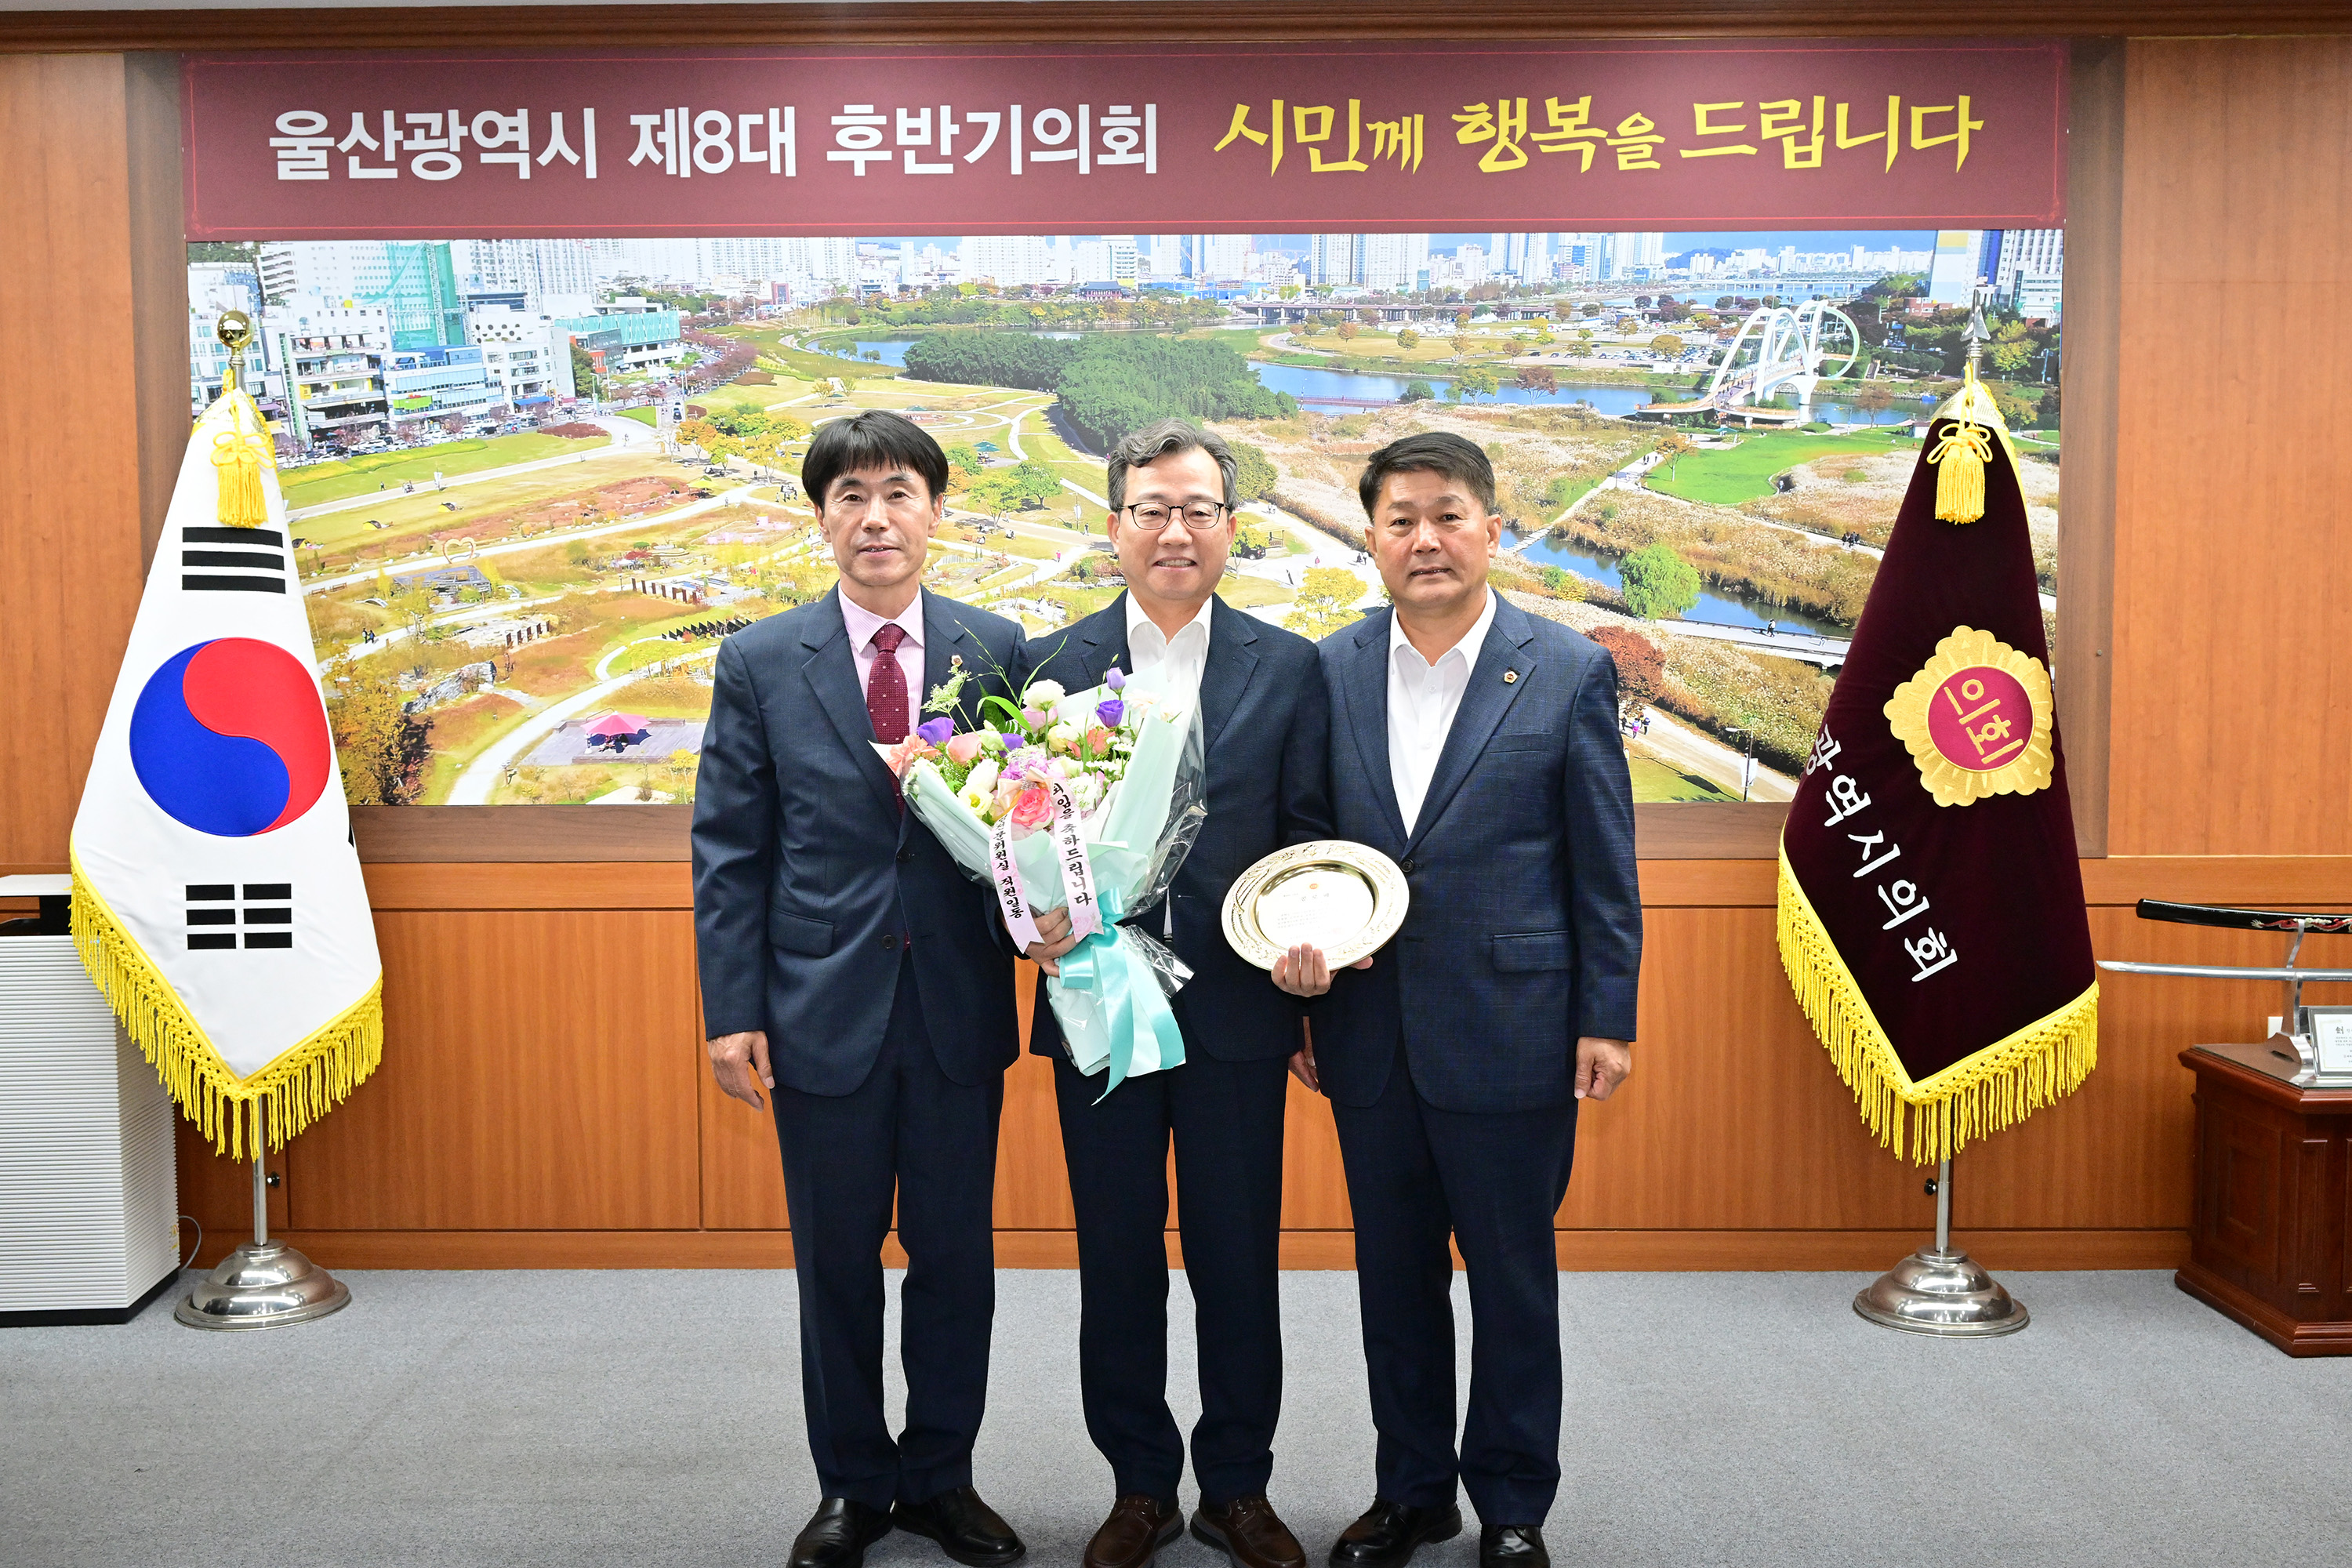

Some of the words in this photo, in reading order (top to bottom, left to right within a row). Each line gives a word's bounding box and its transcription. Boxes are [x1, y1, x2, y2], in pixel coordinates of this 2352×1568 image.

[269, 107, 597, 180] 울산광역시
[627, 106, 797, 178] 제8대
[826, 103, 1157, 176] 후반기의회
[1214, 98, 1425, 177] 시민께
[1451, 95, 1666, 173] 행복을
[1679, 95, 1984, 173] 드립니다
[1943, 677, 2024, 765] 의회
[1000, 876, 1025, 919] 직원일동
[1060, 823, 1093, 906] 축하드립니다
